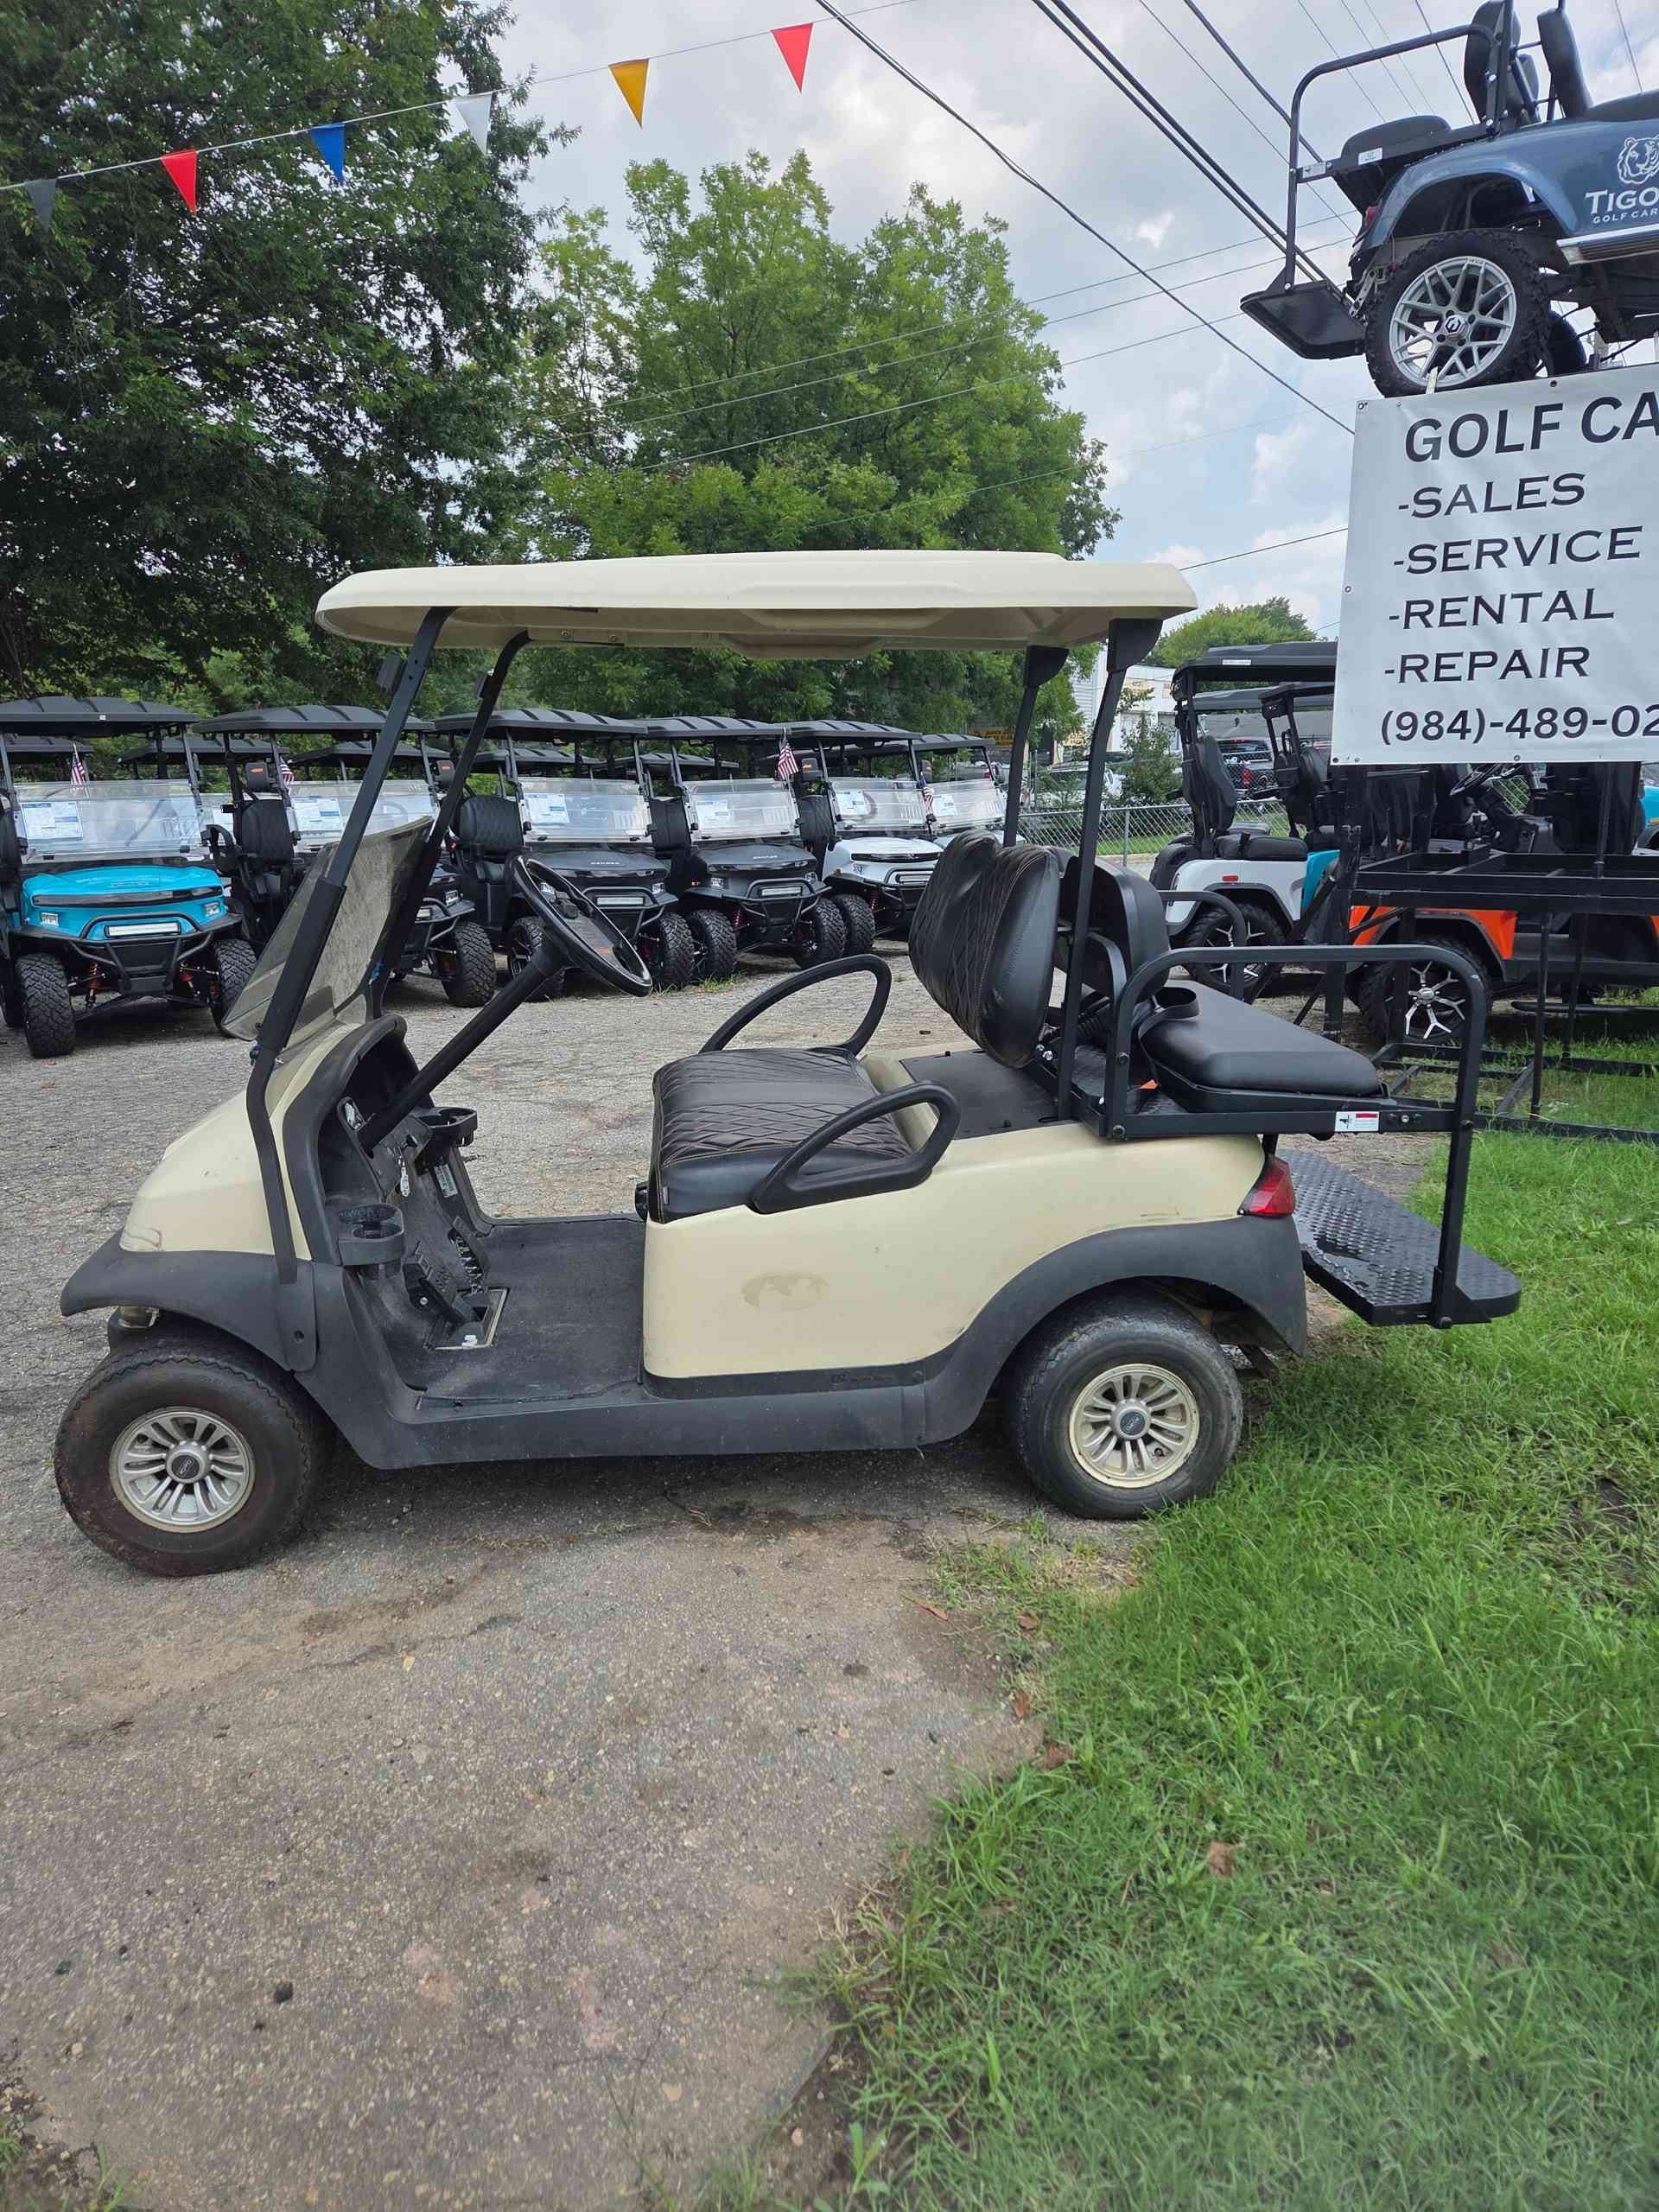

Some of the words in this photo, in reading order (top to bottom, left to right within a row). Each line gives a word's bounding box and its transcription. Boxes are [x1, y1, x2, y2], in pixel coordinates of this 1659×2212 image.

[1592, 213, 1628, 224] GOLF
[1405, 402, 1564, 462] GOLF
[1398, 473, 1586, 518] -SALES
[1394, 525, 1643, 575] -SERVICE
[1389, 588, 1614, 630] -RENTAL
[1384, 646, 1590, 683] -REPAIR
